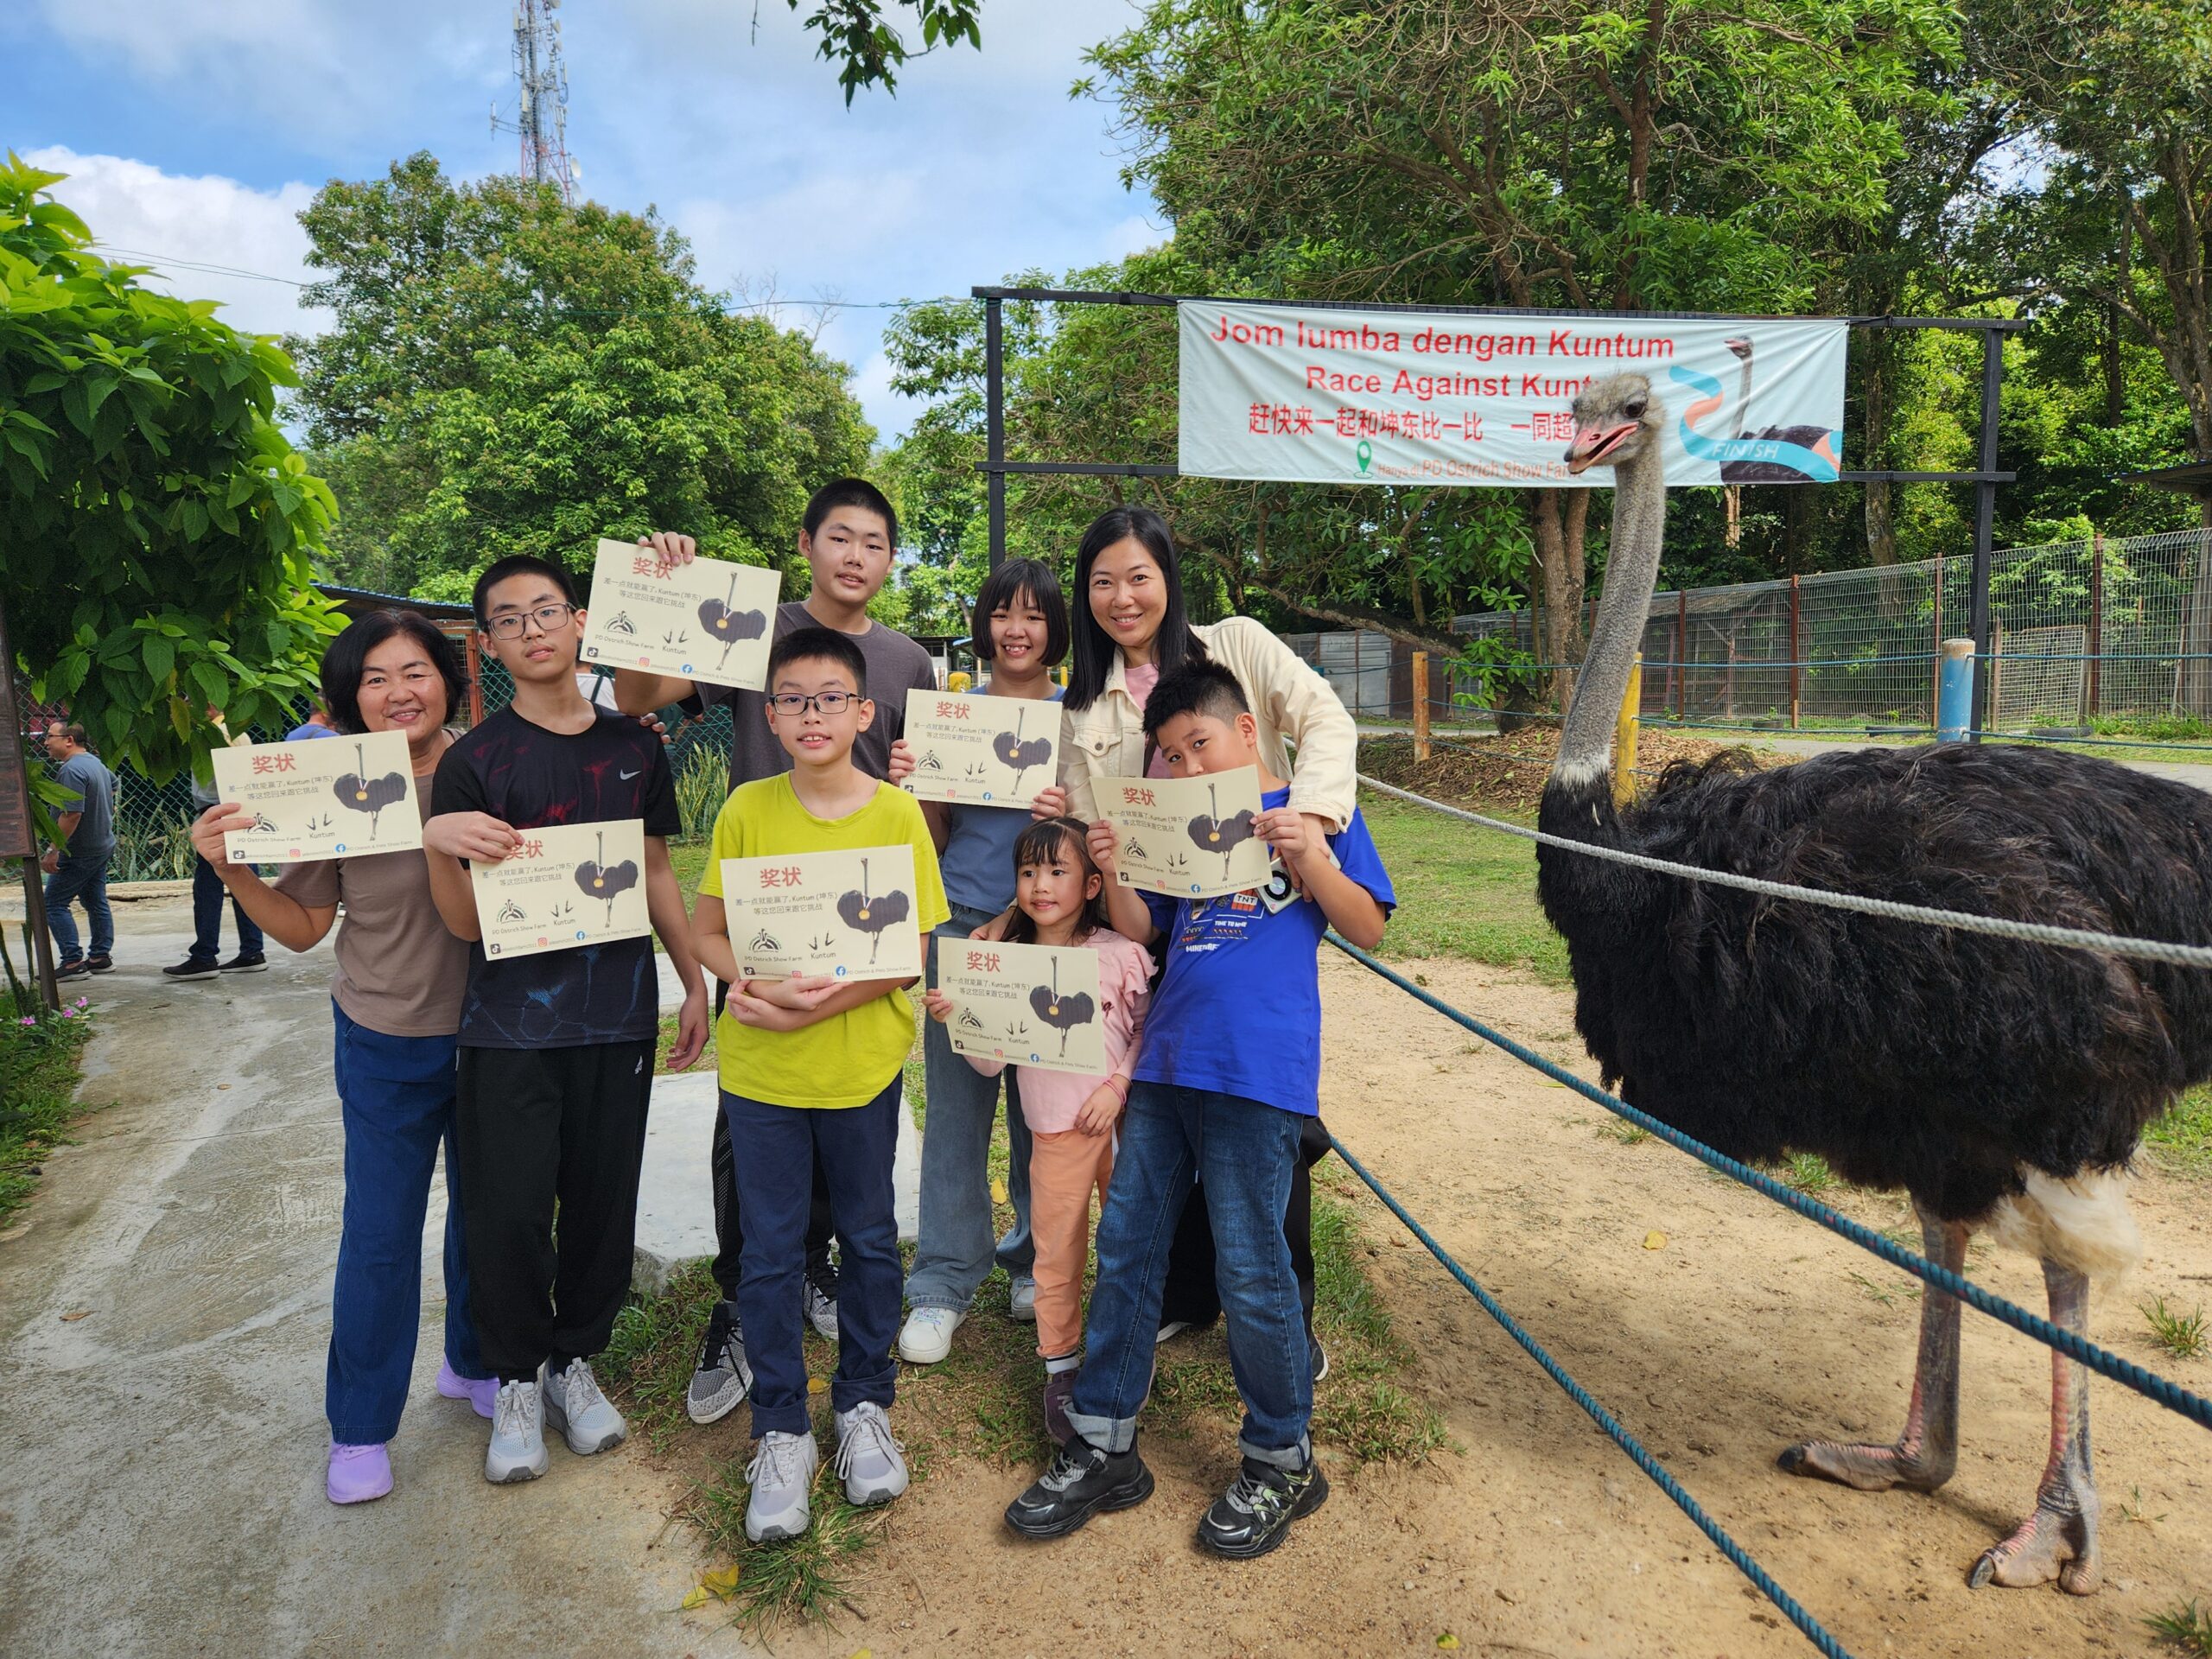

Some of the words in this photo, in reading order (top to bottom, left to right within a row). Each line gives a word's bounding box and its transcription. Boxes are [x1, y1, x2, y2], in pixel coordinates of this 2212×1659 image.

[1211, 316, 1284, 346] Jom
[1297, 321, 1400, 352] lumba
[1412, 327, 1535, 361] dengan
[1549, 329, 1674, 358] Kuntum
[1306, 366, 1381, 393] Race
[1391, 370, 1511, 401] Against
[1249, 402, 1484, 442] 赶快来一起和坤东比一比
[1713, 442, 1780, 459] FINISH
[1422, 459, 1442, 475] PD
[1446, 460, 1499, 478] Ostrich
[1503, 461, 1542, 478] Show
[1547, 461, 1581, 478] Far
[632, 556, 674, 581] 奖状
[662, 645, 686, 655] Kuntum
[936, 701, 971, 720] 奖状
[251, 753, 296, 774] 奖状
[1122, 787, 1156, 807] 奖状
[760, 866, 802, 888] 奖状
[967, 951, 1001, 972] 奖状
